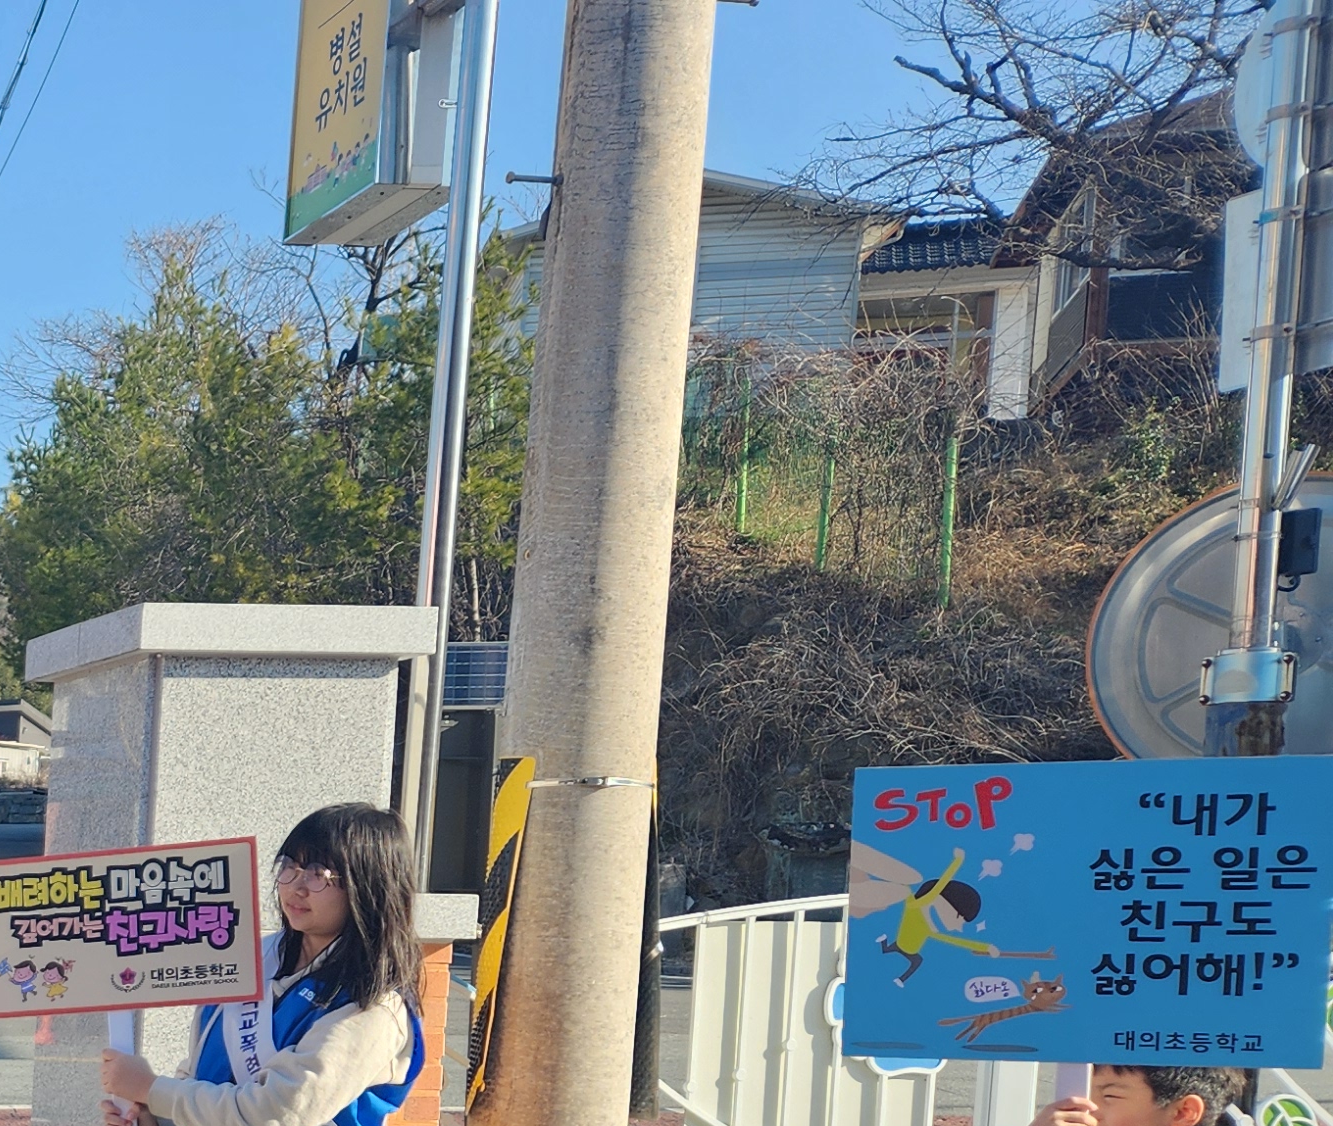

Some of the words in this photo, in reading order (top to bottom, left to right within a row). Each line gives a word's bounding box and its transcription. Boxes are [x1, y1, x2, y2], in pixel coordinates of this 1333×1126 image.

[330, 13, 362, 75] 병설
[315, 57, 367, 132] 유치원
[874, 776, 1012, 832] STOP
[108, 860, 225, 904] 마음속에
[1089, 845, 1190, 891] 싫은
[1213, 844, 1317, 891] 일은
[14, 914, 104, 943] 깊어가는
[106, 906, 233, 952] 친구사랑
[1121, 901, 1276, 942] 친구도
[151, 964, 239, 981] 대의초등학교
[172, 980, 212, 989] ELEMENTARY
[213, 977, 239, 985] SCHOOL
[1114, 1031, 1264, 1053] 대의초등학교
